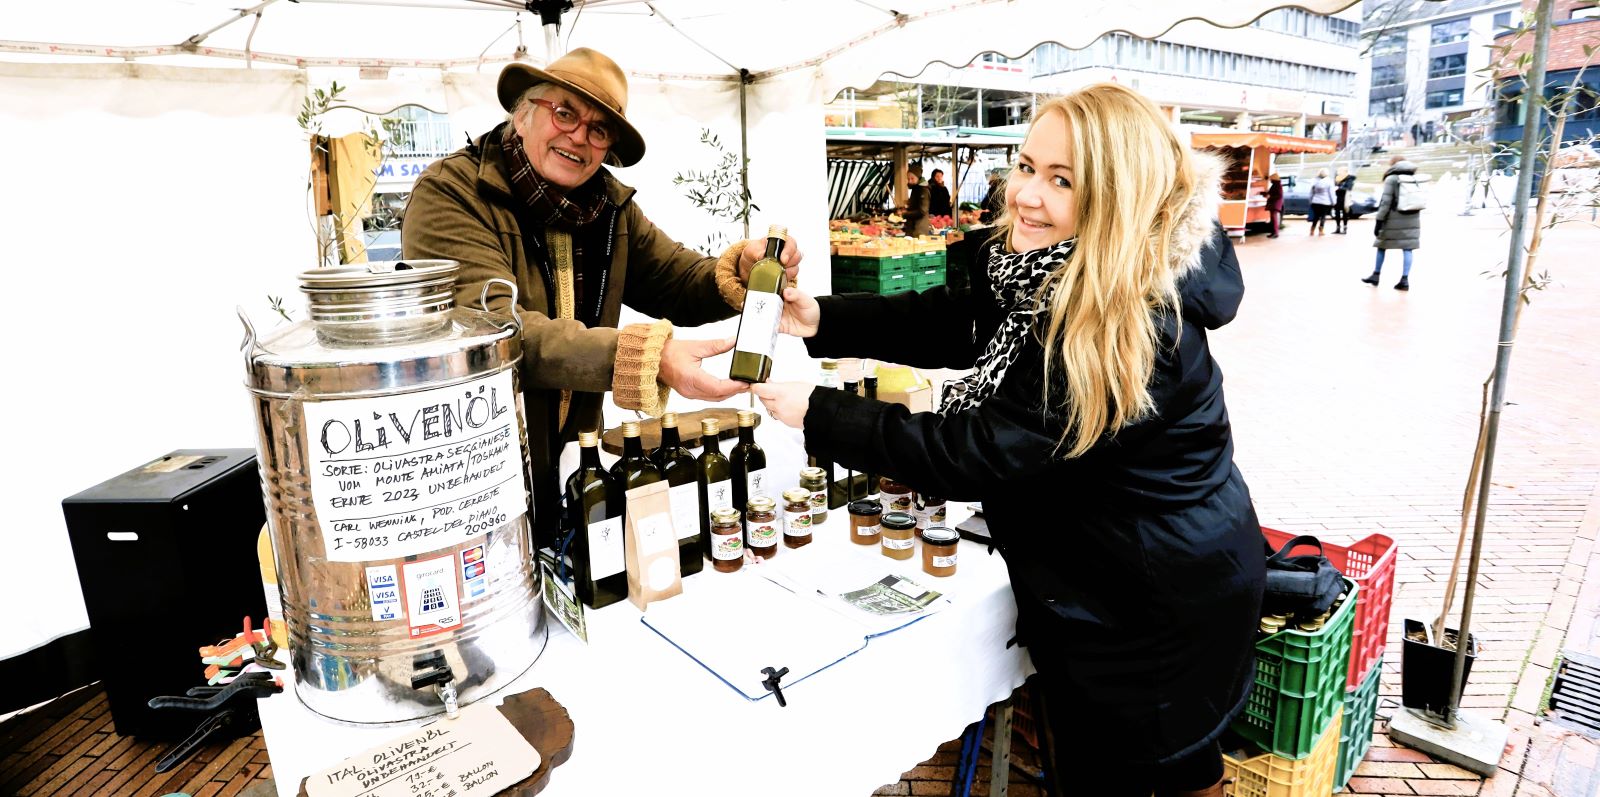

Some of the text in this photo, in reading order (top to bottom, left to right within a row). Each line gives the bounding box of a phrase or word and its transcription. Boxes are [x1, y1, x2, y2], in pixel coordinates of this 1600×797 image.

[322, 464, 368, 477] SORTE:
[329, 494, 373, 508] ERNTE
[428, 459, 506, 495] UNBEHANDELT
[338, 479, 361, 492] VOM
[375, 470, 415, 487] MONTE
[333, 522, 362, 532] CARL
[373, 575, 393, 584] VISA
[376, 591, 396, 599] VISA
[458, 760, 494, 783] BALLON
[463, 769, 499, 791] BALLON
